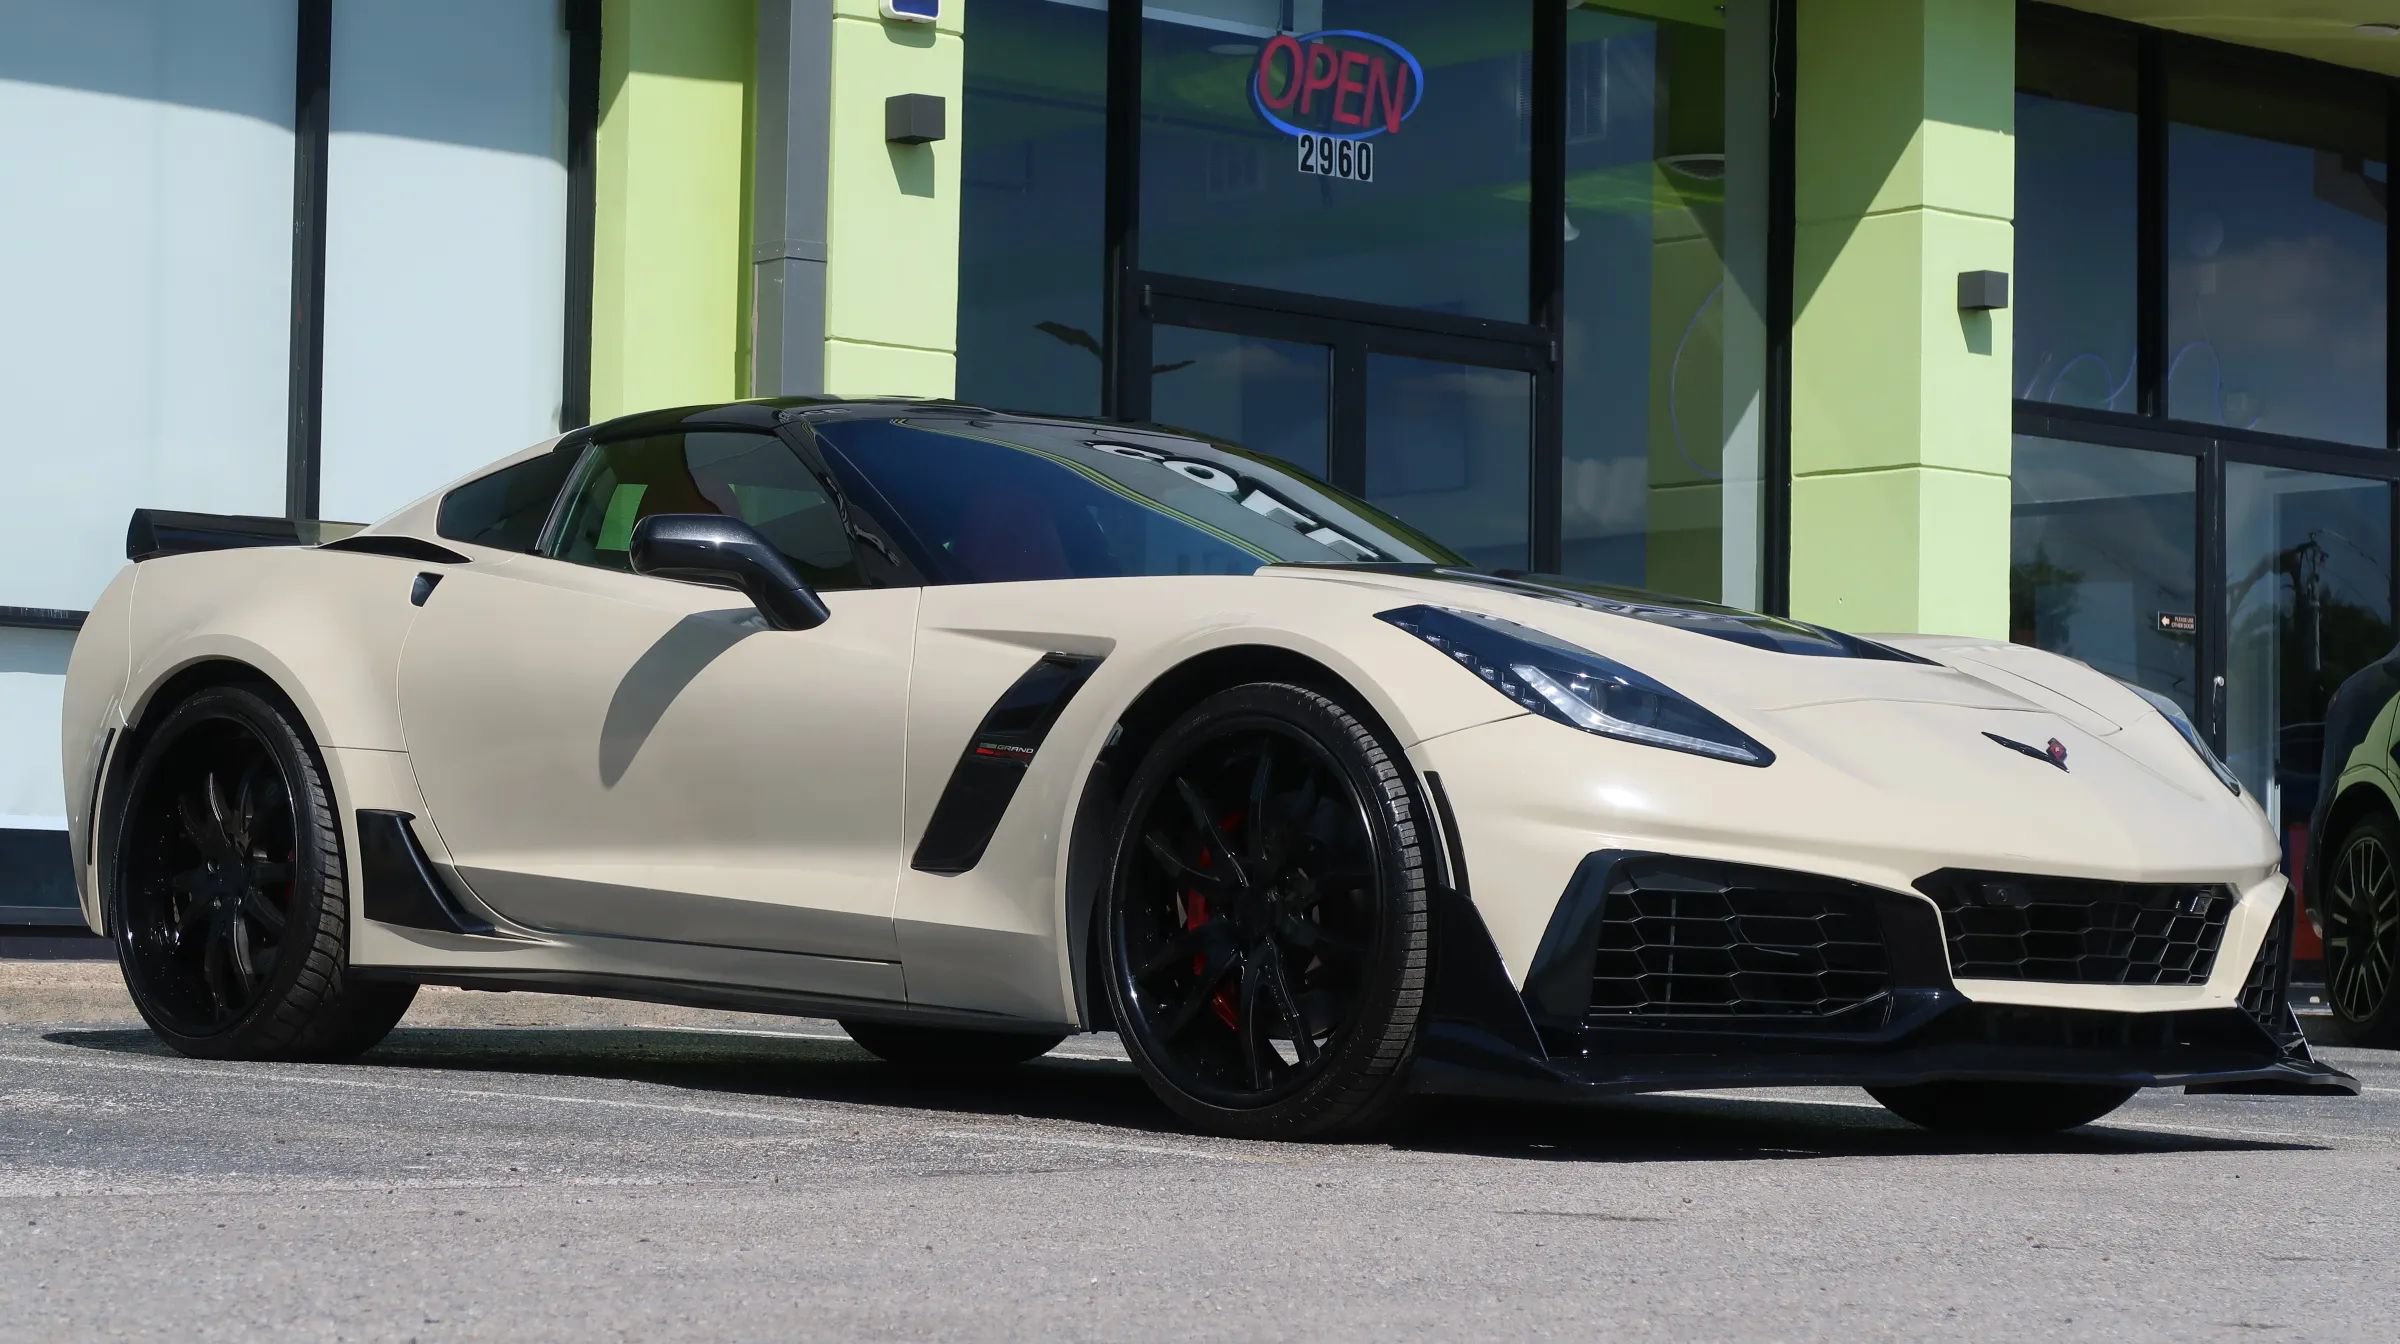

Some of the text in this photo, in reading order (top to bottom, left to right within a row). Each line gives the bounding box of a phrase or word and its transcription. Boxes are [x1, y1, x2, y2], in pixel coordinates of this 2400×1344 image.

[1259, 35, 1408, 134] OPEN
[1300, 134, 1371, 179] 2960
[997, 744, 1034, 754] GRAND
